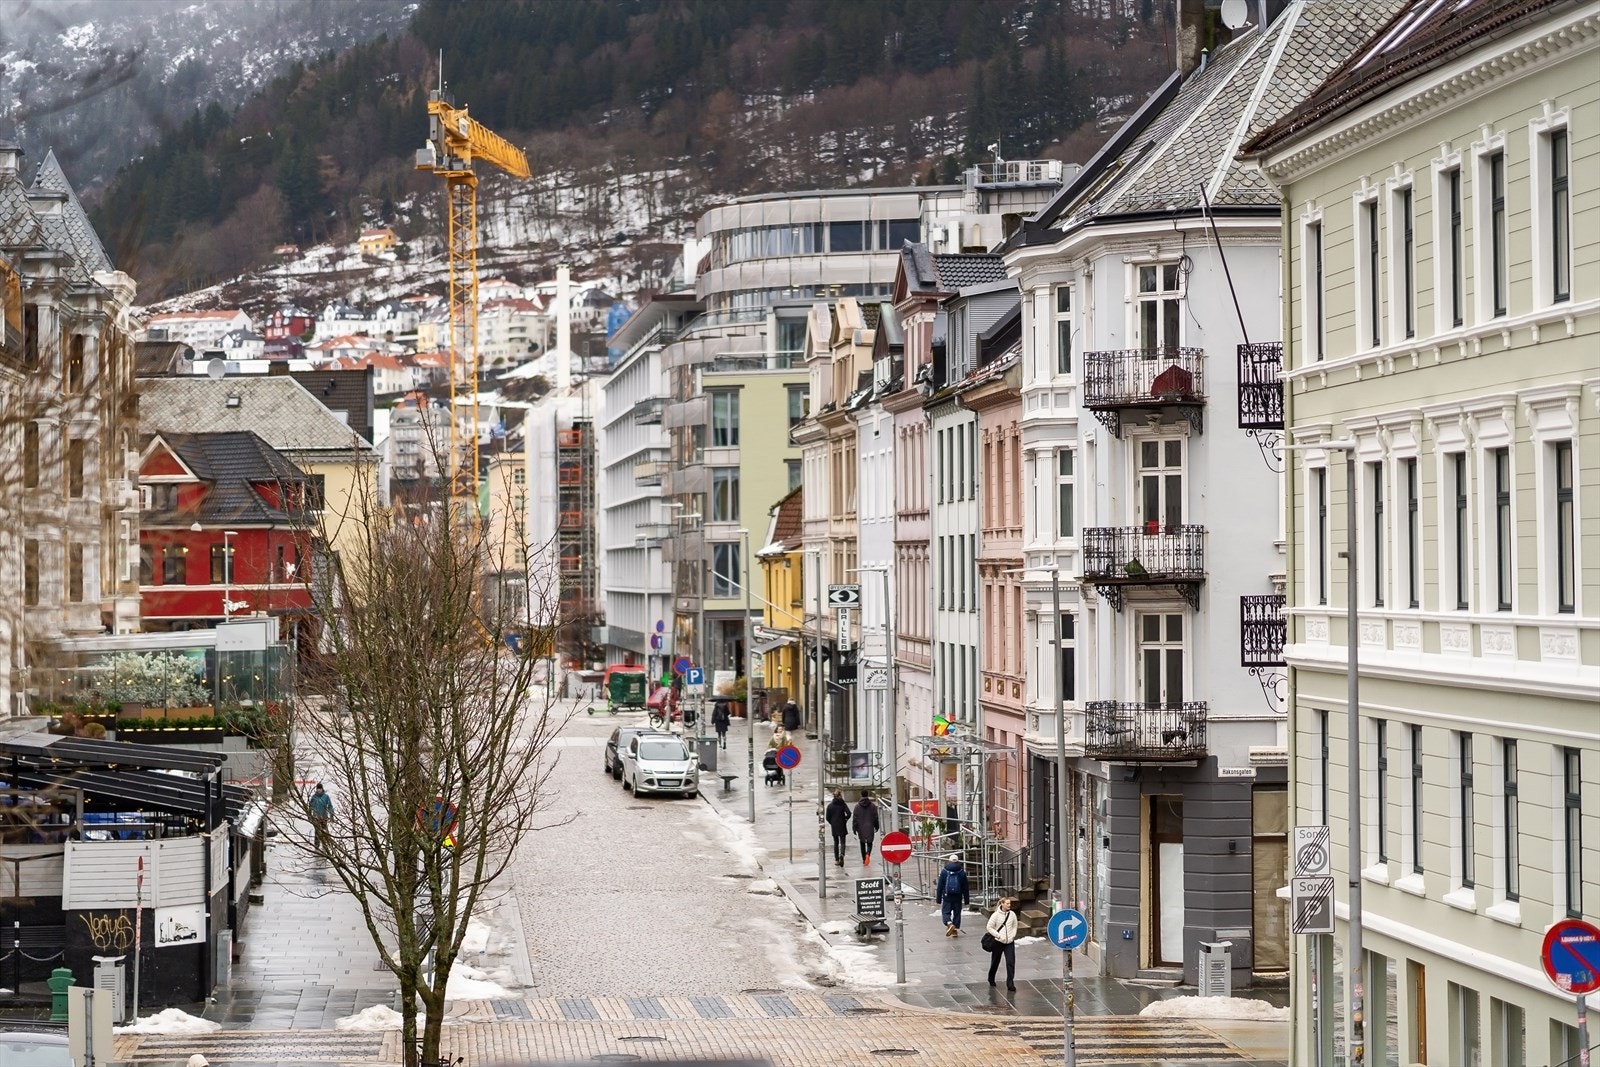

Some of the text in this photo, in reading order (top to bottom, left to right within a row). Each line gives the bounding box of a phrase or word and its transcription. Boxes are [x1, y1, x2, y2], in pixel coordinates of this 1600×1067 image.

[690, 669, 699, 683] P
[866, 669, 888, 683] SKOMAK
[1299, 829, 1321, 839] Son
[860, 881, 879, 889] Scott
